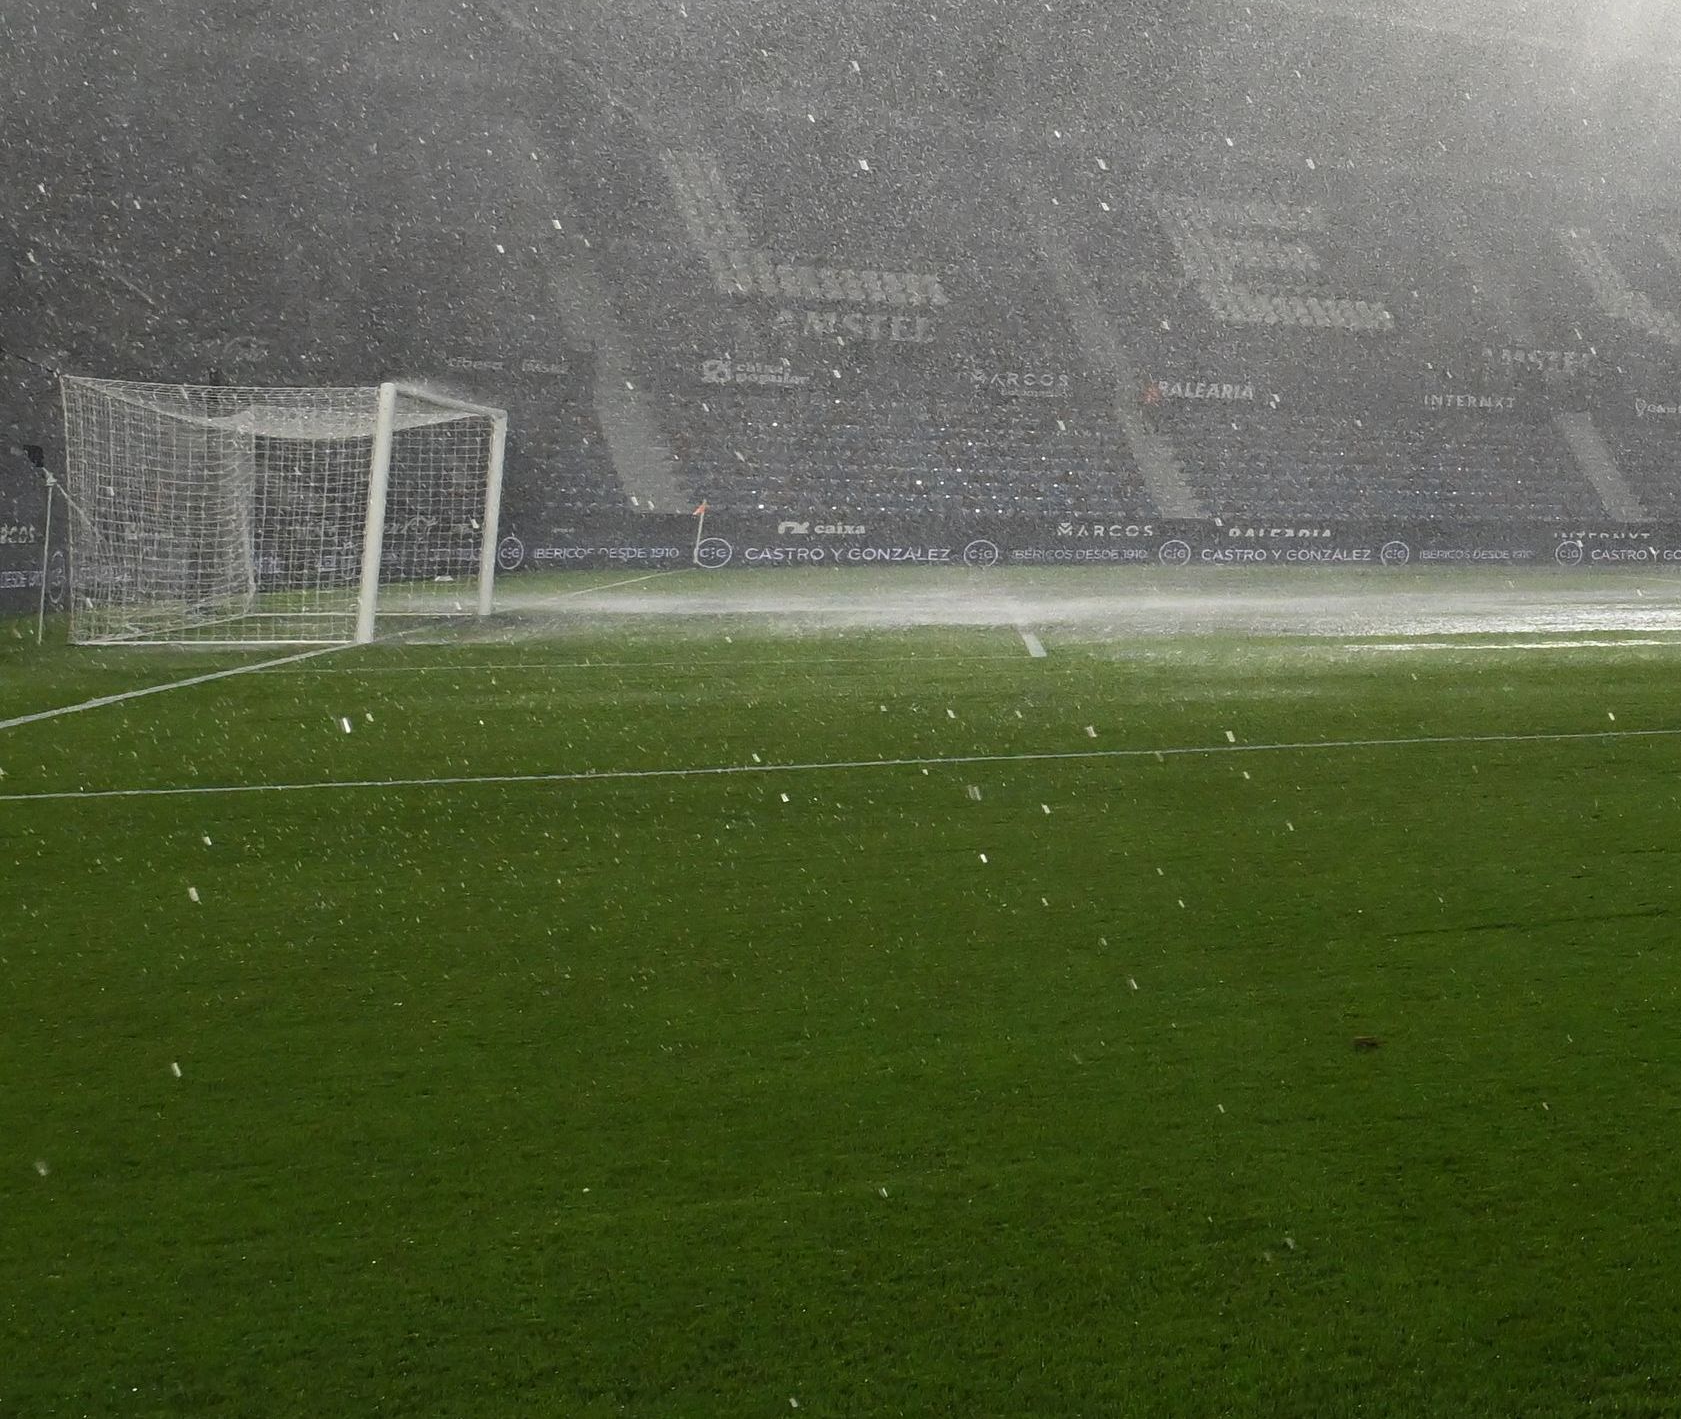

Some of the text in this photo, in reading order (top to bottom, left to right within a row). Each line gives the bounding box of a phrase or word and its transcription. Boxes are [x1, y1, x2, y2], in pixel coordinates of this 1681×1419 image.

[814, 522, 866, 534] caixa
[1057, 523, 1153, 537] MARCOS
[745, 546, 951, 561] CASTRO Y GONZÁLEZ
[1201, 547, 1372, 561] CASTRO Y GONZÁLEZ
[1591, 549, 1646, 561] CASTRO
[1648, 549, 1660, 561] Y
